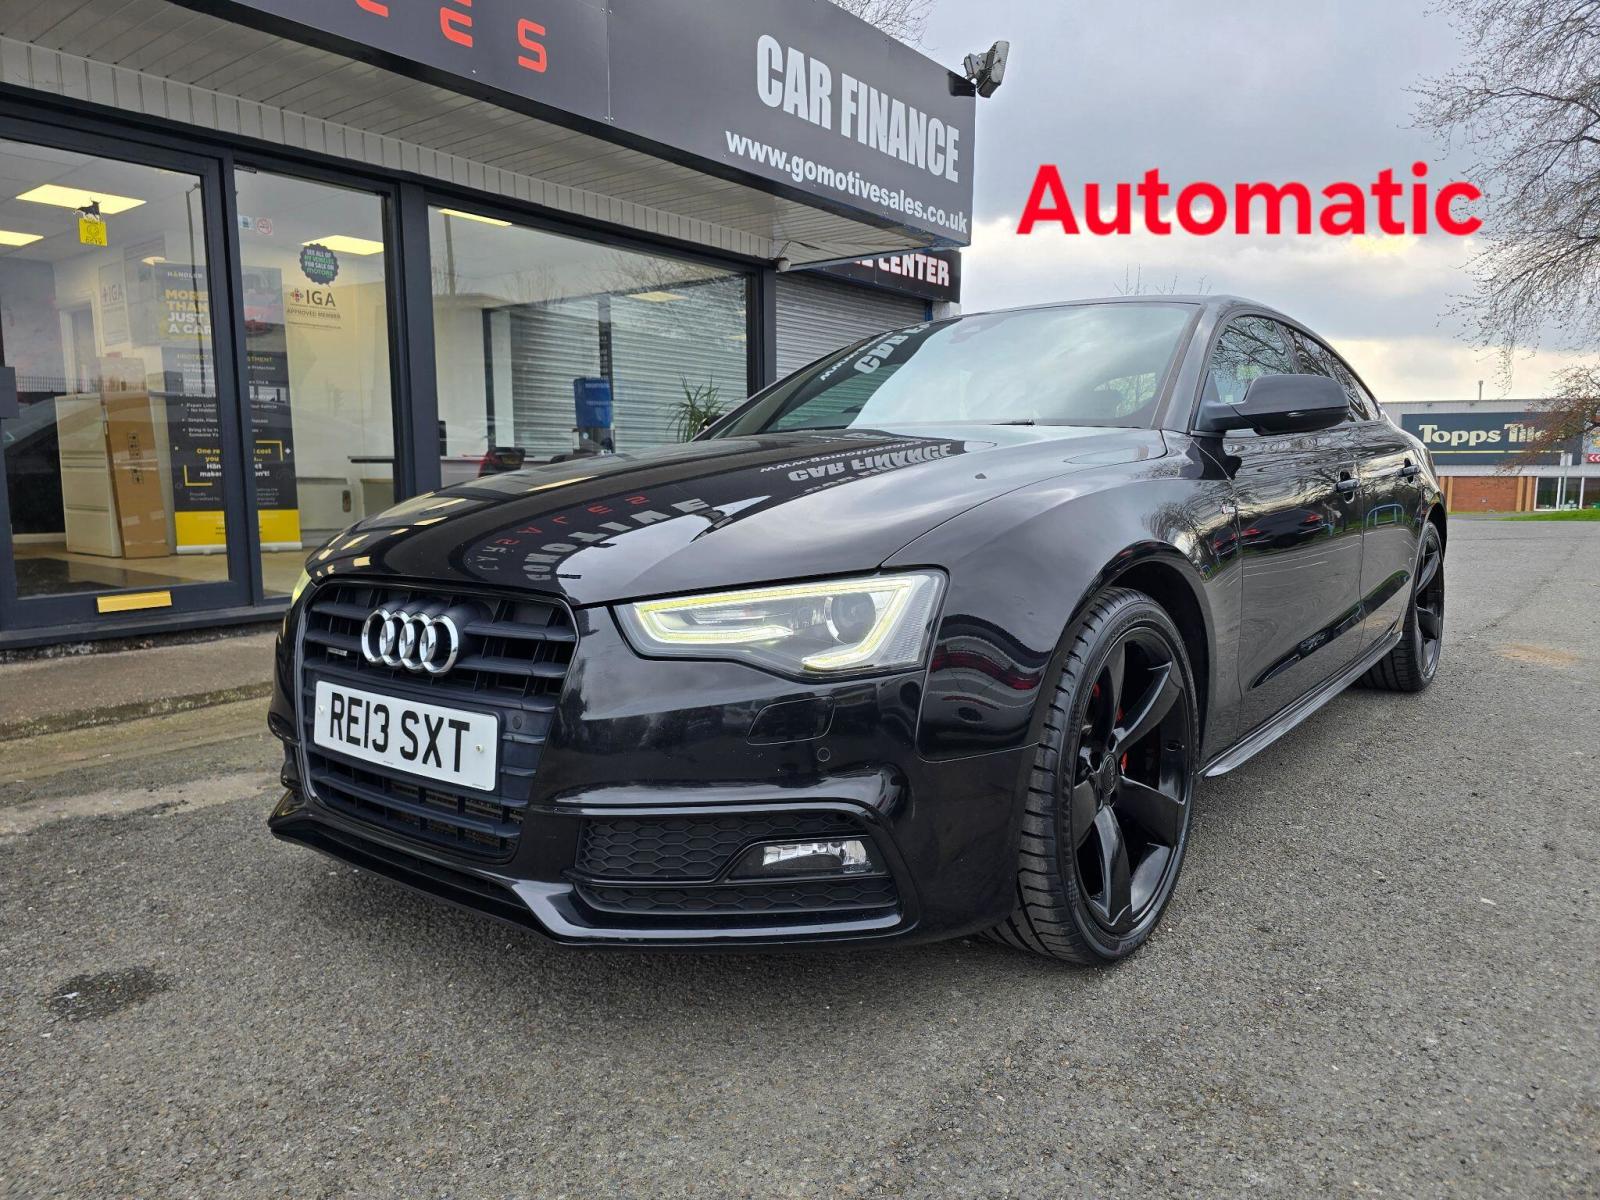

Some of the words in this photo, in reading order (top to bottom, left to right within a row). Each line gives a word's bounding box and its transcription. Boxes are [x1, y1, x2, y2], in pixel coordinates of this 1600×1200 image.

[757, 34, 832, 130] CAR
[841, 72, 960, 183] FINANCE
[725, 130, 968, 234] www.gomotivesales.co.uk
[306, 289, 336, 307] IGA
[167, 311, 205, 323] JUST
[168, 323, 180, 334] A
[1418, 424, 1501, 447] Topps
[330, 692, 390, 753] RE13
[400, 710, 471, 773] SXT
